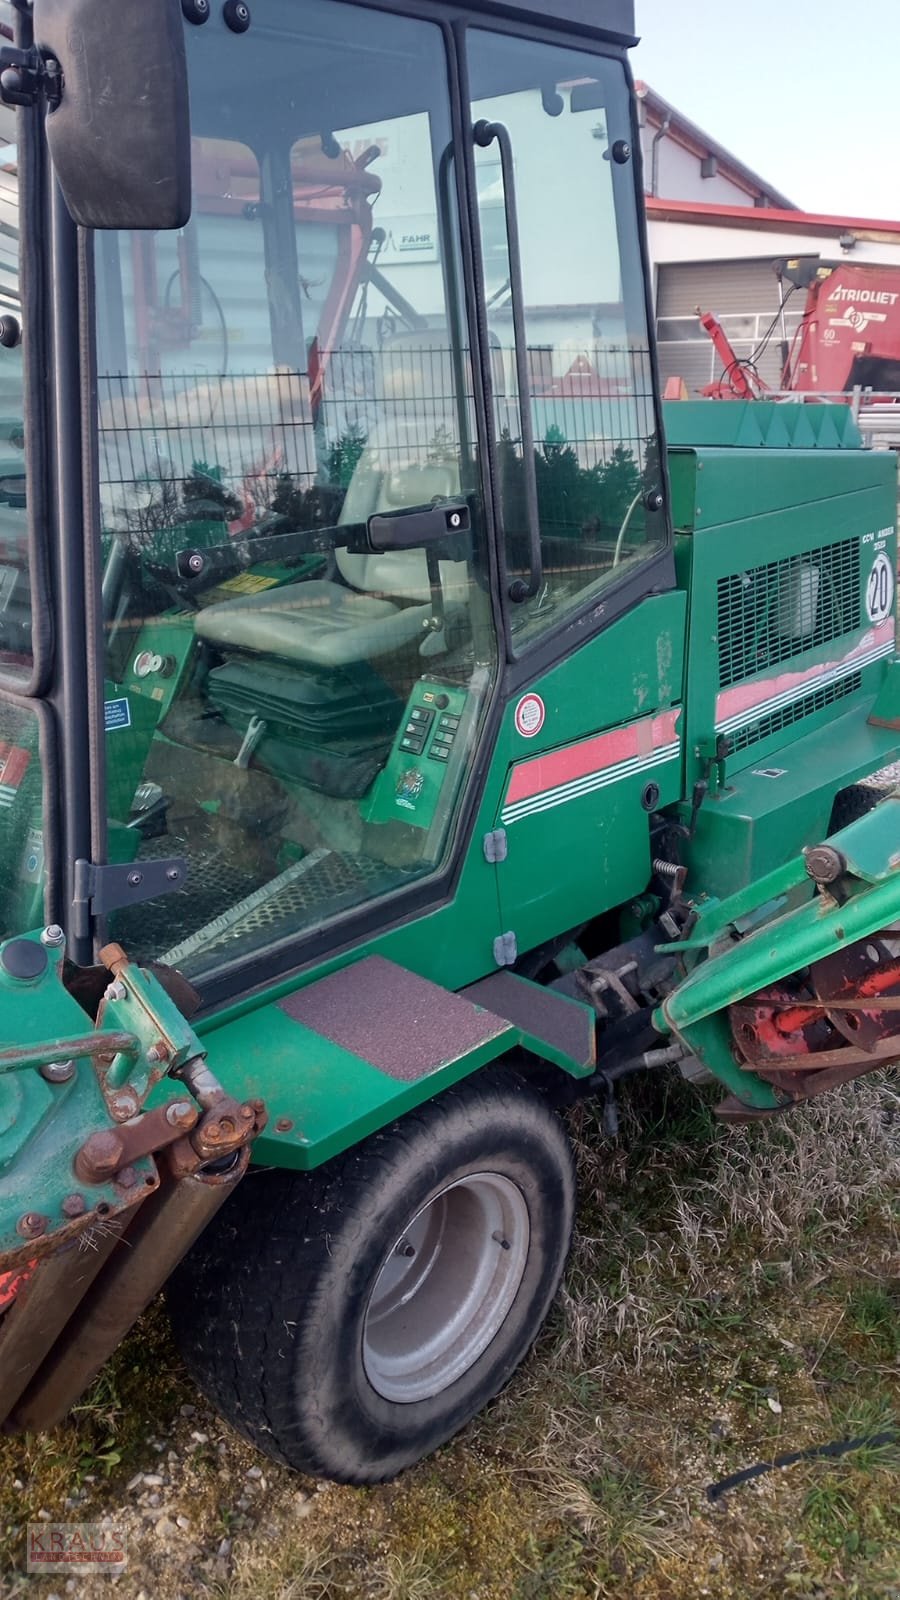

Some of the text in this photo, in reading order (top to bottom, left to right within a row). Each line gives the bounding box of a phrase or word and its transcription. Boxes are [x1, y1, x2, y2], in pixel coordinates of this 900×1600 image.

[402, 234, 430, 244] FAHR
[841, 288, 899, 305] TRIOLIET
[871, 564, 888, 616] 20
